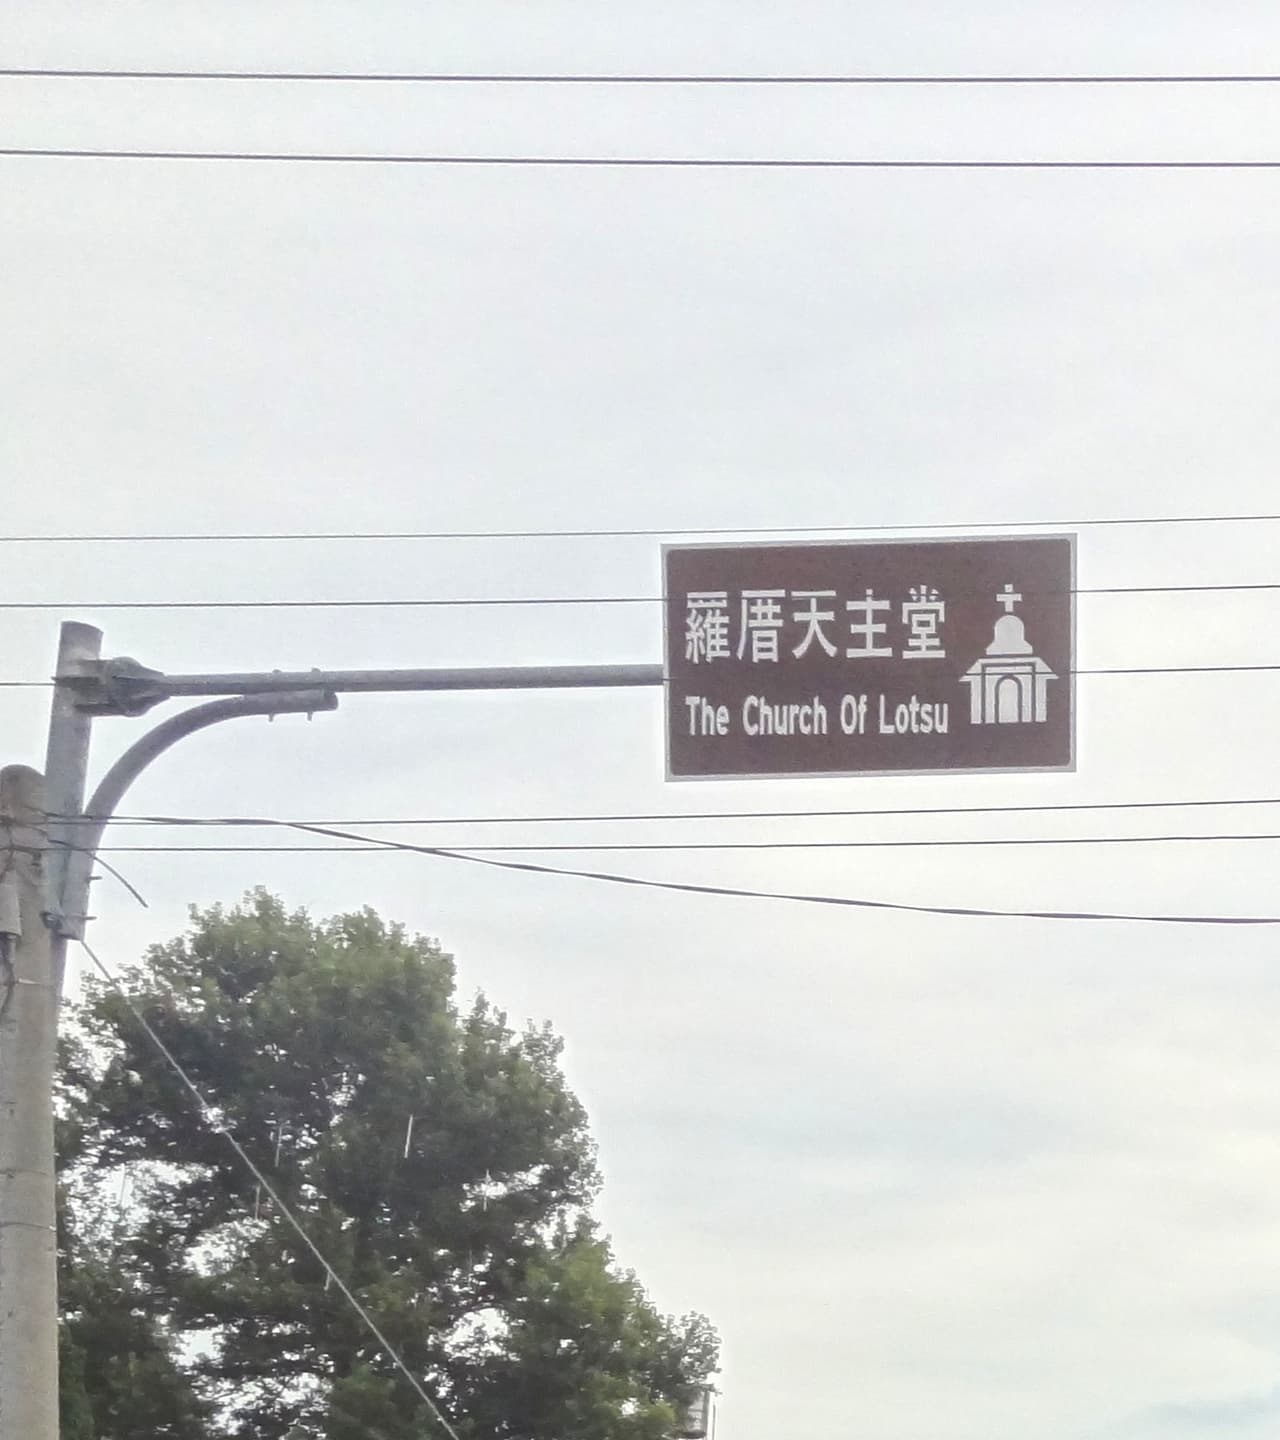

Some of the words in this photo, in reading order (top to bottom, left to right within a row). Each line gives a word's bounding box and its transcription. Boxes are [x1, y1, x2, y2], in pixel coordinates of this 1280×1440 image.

[686, 585, 946, 664] 羅厝天主堂
[685, 696, 730, 736] The
[742, 695, 828, 735] Church
[840, 695, 868, 735] Of
[879, 694, 949, 735] Lotsu
